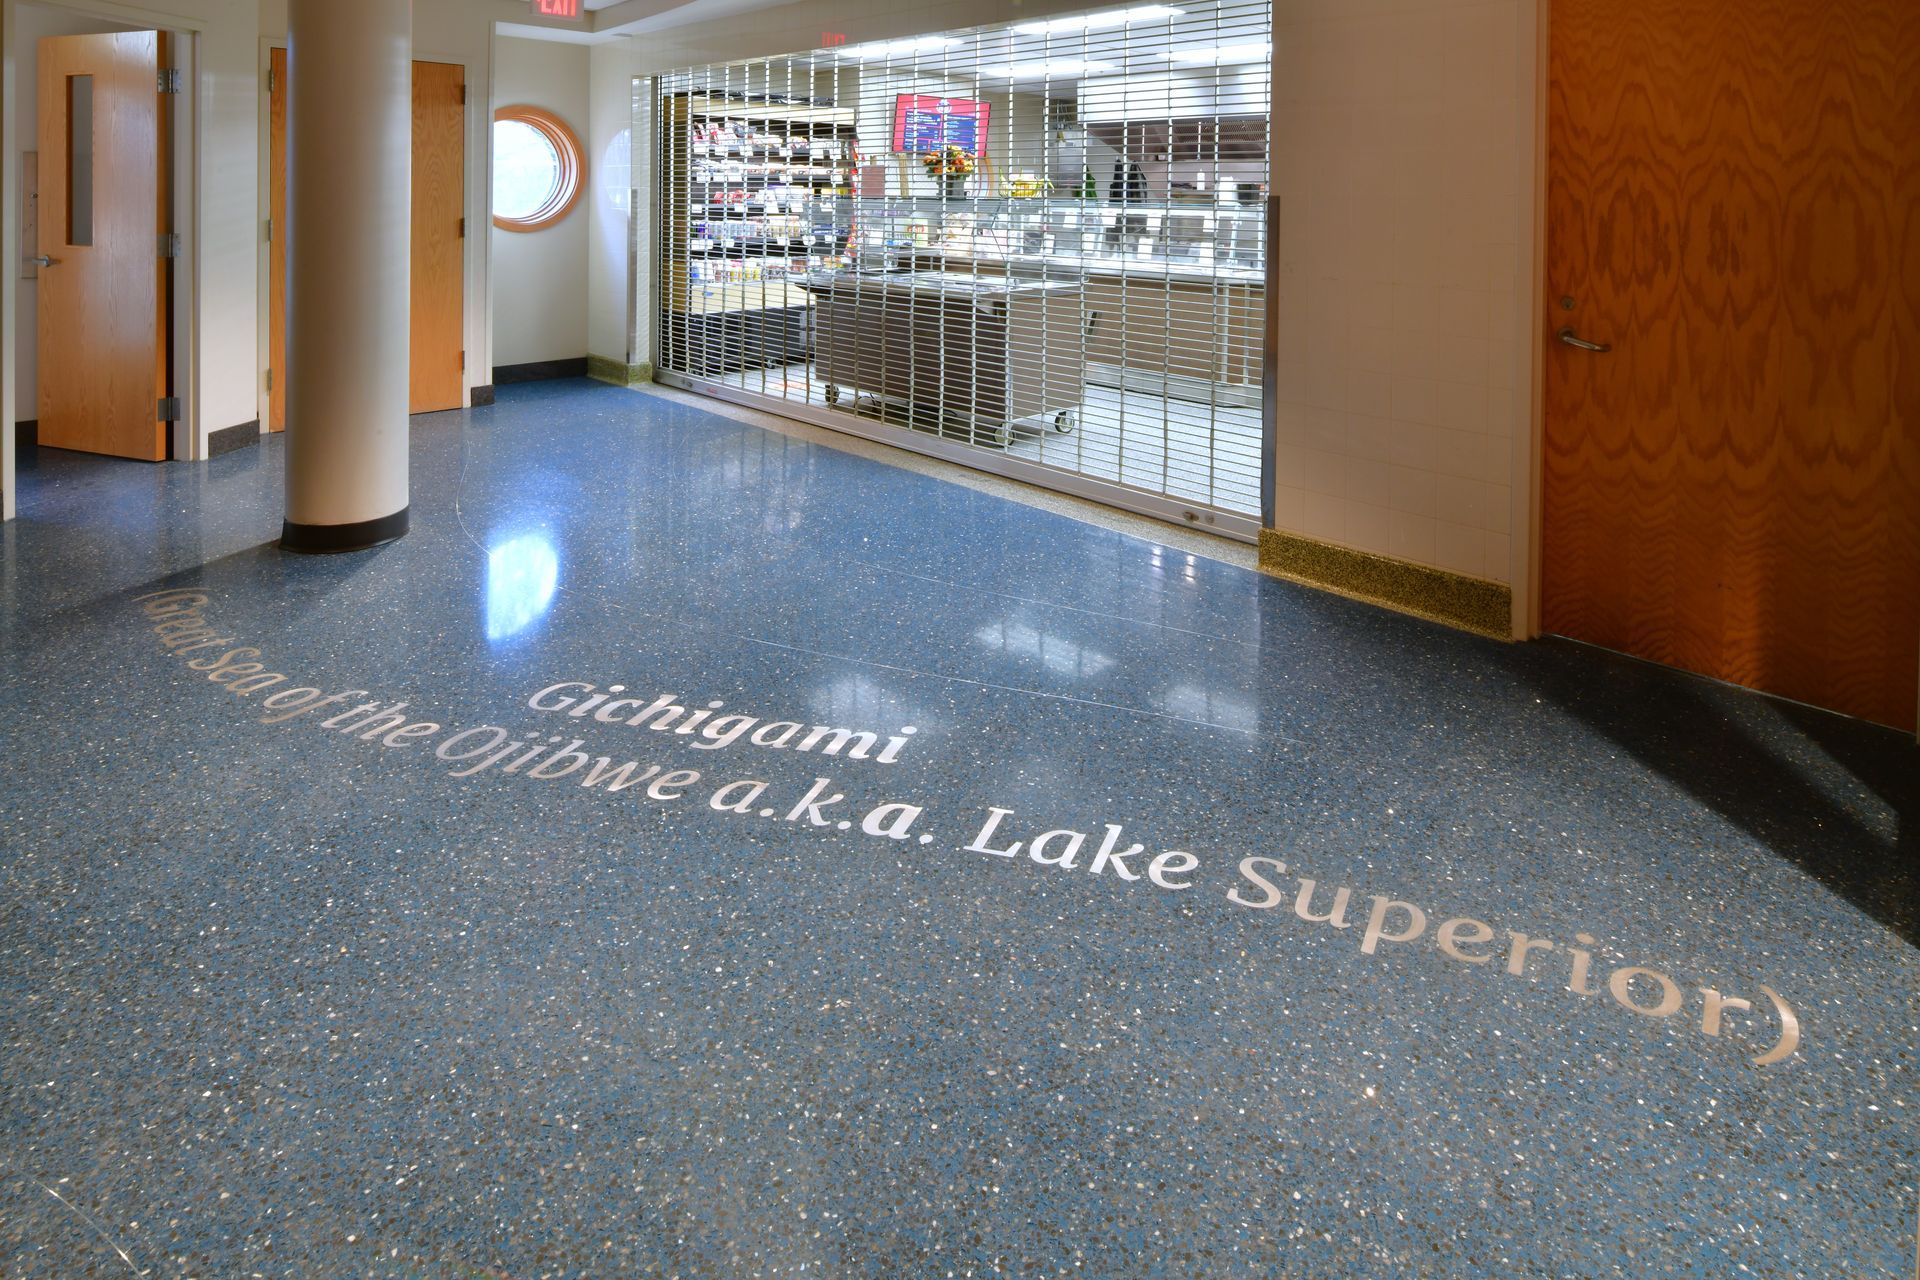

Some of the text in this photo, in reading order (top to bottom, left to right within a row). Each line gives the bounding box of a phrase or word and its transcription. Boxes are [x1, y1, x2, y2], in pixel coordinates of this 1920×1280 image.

[527, 681, 918, 764] Gichigami
[186, 647, 289, 698] Sea
[259, 687, 369, 724] of
[320, 701, 441, 748] the
[435, 726, 701, 800] Ojibwe
[708, 777, 934, 844] a.k.a.
[963, 806, 1199, 889] Lake
[1225, 855, 1800, 1066] Superior)
